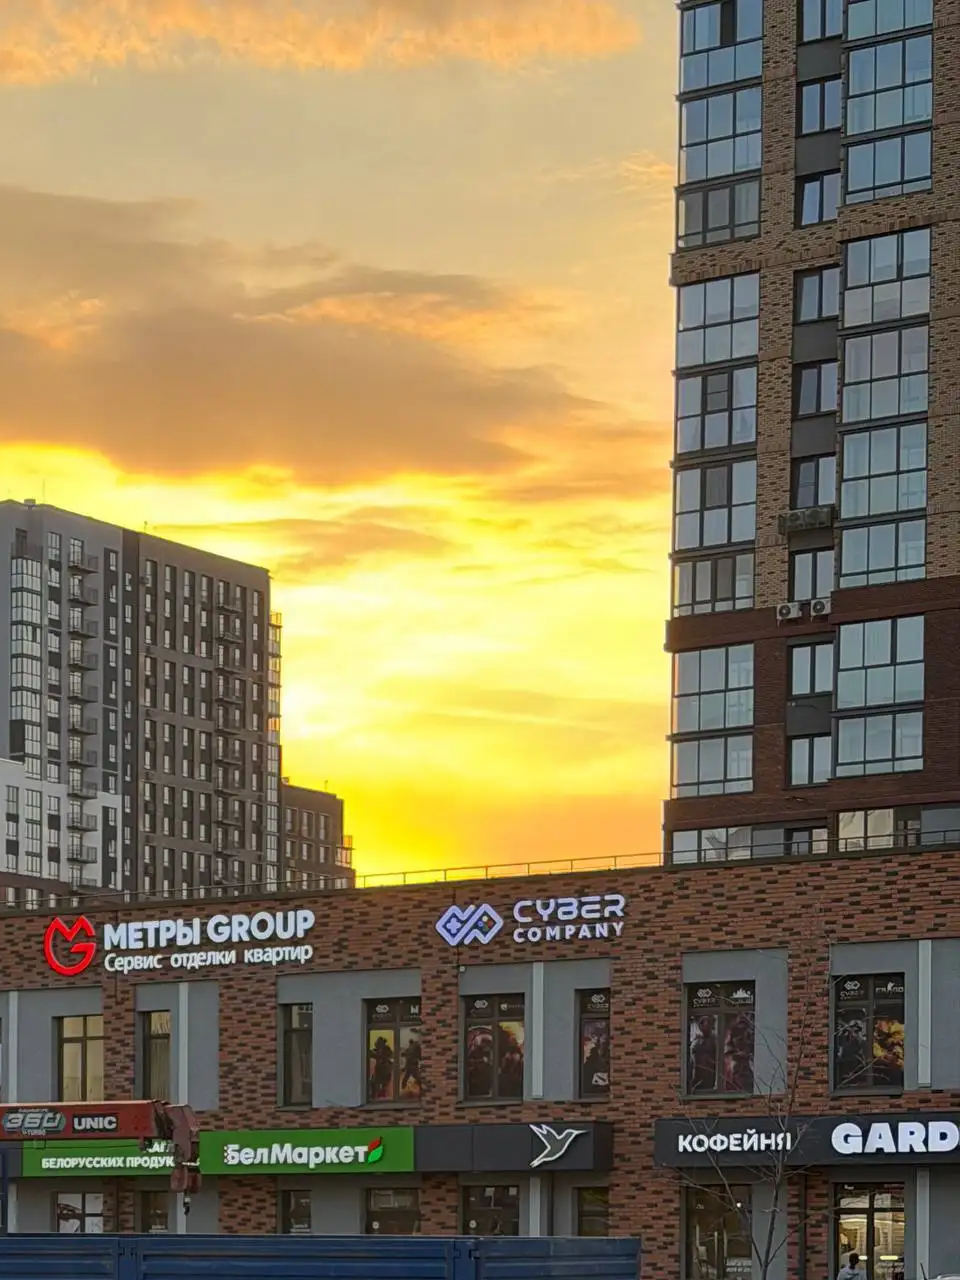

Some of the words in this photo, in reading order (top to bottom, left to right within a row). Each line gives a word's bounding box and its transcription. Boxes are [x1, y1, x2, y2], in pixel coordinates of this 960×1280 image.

[513, 894, 626, 924] CYBER
[104, 917, 200, 950] МЕТРЫ
[206, 909, 316, 944] GROUP
[513, 920, 626, 943] COMPANY
[104, 951, 163, 975] Сервис
[170, 949, 236, 971] отделки
[243, 944, 313, 966] квартир
[73, 1116, 117, 1131] UNIC
[678, 1129, 792, 1153] КОФЕЙНЯ
[831, 1121, 960, 1155] GARD
[41, 1156, 124, 1169] БЕЛОРУССКИХ
[224, 1142, 370, 1168] БелМаркет
